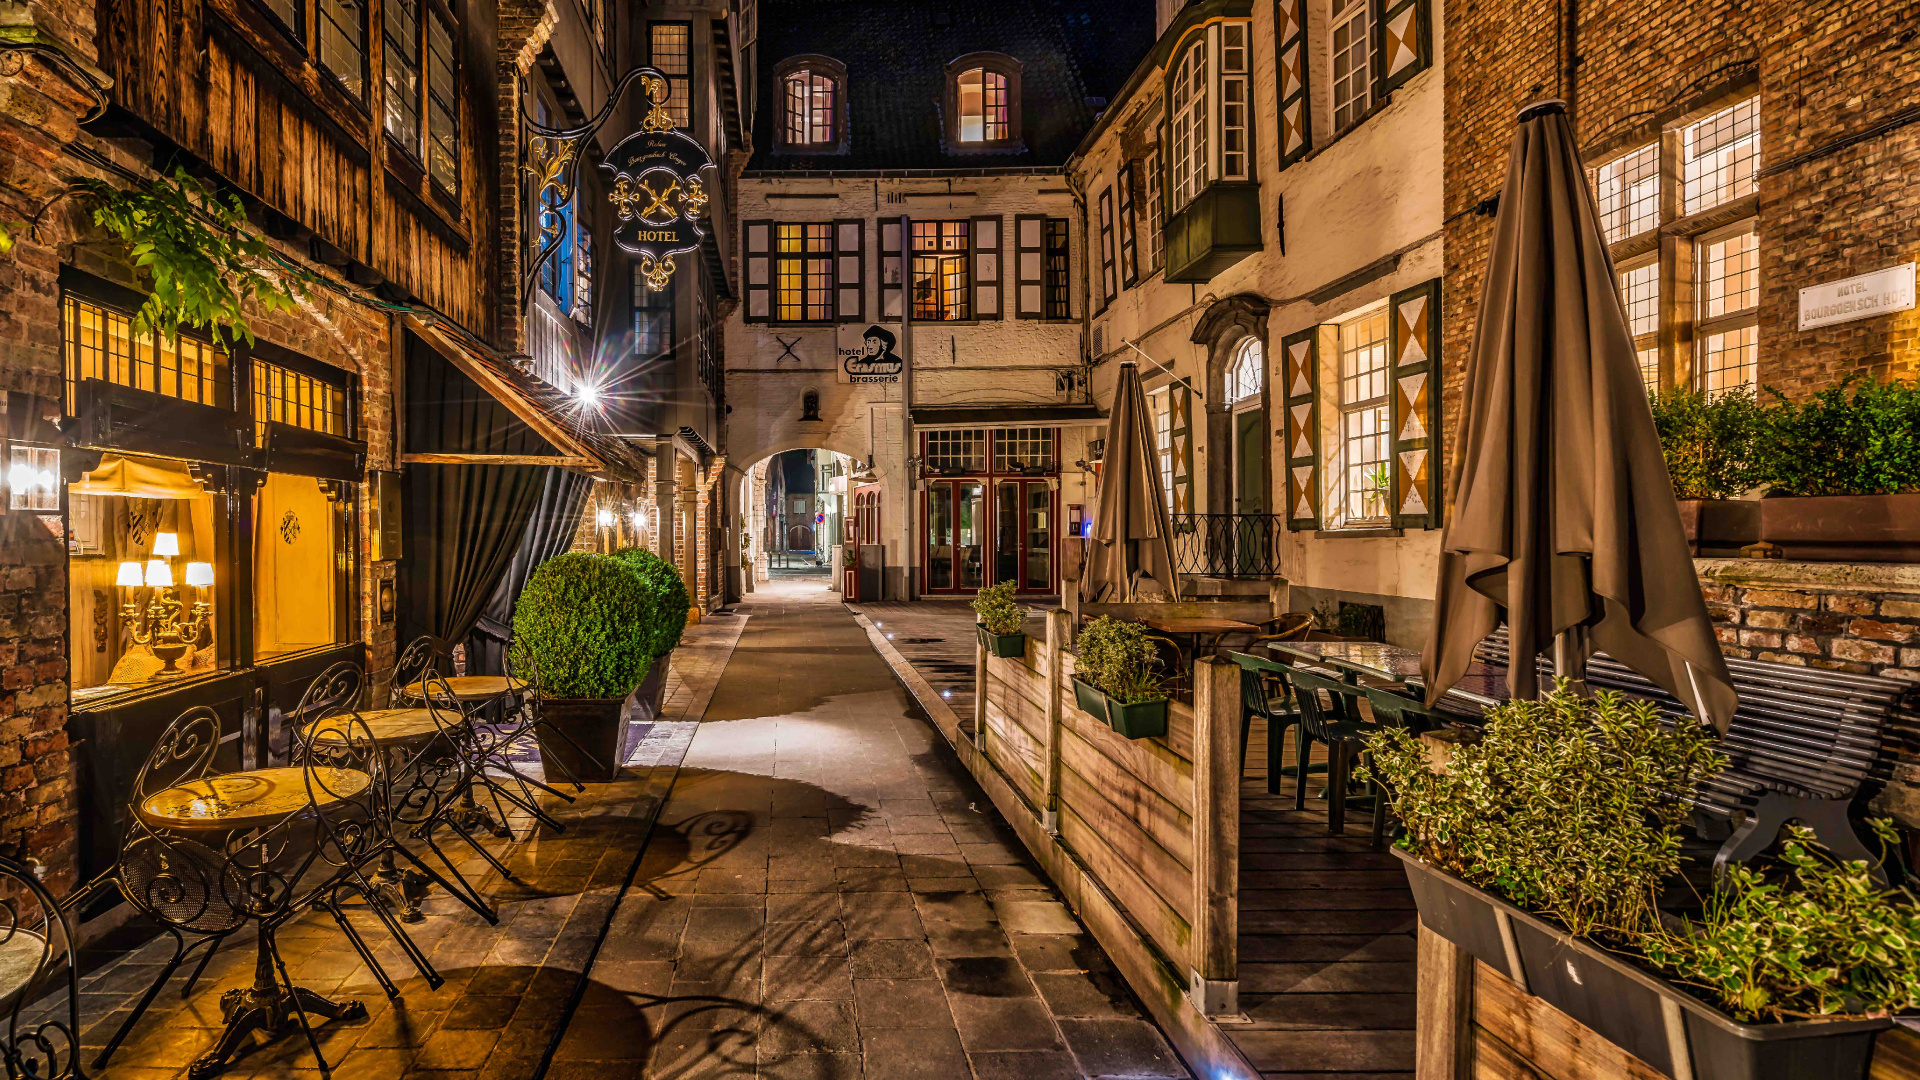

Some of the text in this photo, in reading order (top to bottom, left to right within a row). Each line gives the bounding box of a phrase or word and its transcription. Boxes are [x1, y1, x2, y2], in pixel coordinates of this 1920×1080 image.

[637, 230, 680, 242] HOTEL
[1837, 282, 1867, 298] HOTEL
[1804, 289, 1906, 321] BOURGOENSCH HOF
[838, 347, 865, 355] hotel
[845, 357, 901, 374] Erasmus
[849, 375, 898, 383] brasserie
